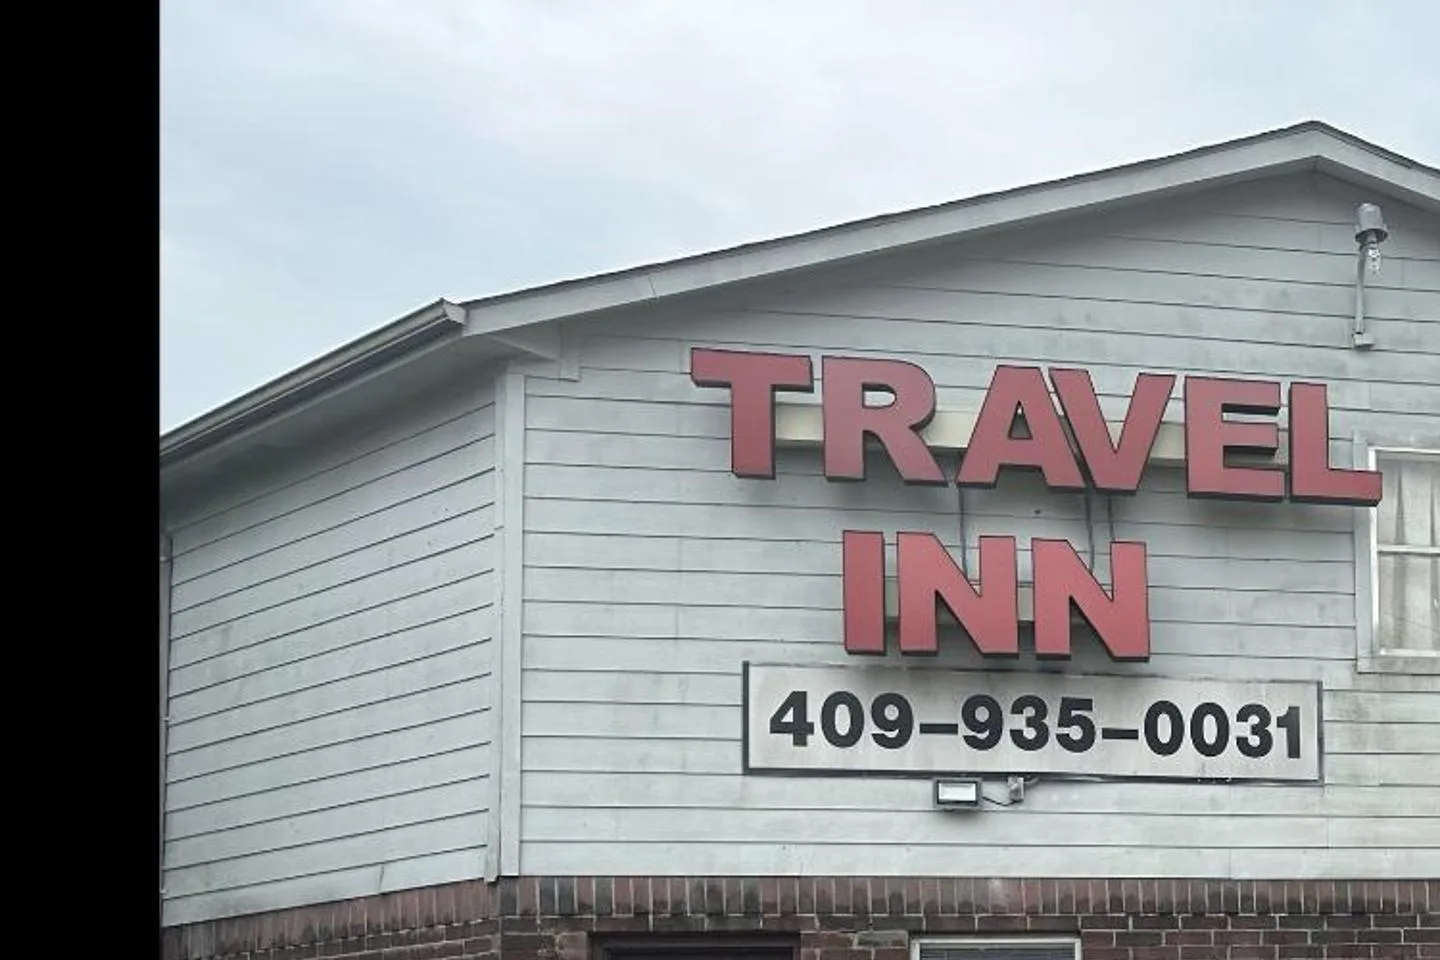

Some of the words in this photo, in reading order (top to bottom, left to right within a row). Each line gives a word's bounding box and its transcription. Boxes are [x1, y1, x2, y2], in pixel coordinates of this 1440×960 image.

[690, 347, 1383, 506] TRAVEL
[842, 530, 1152, 662] INN
[769, 690, 1302, 760] 409-935-0031
